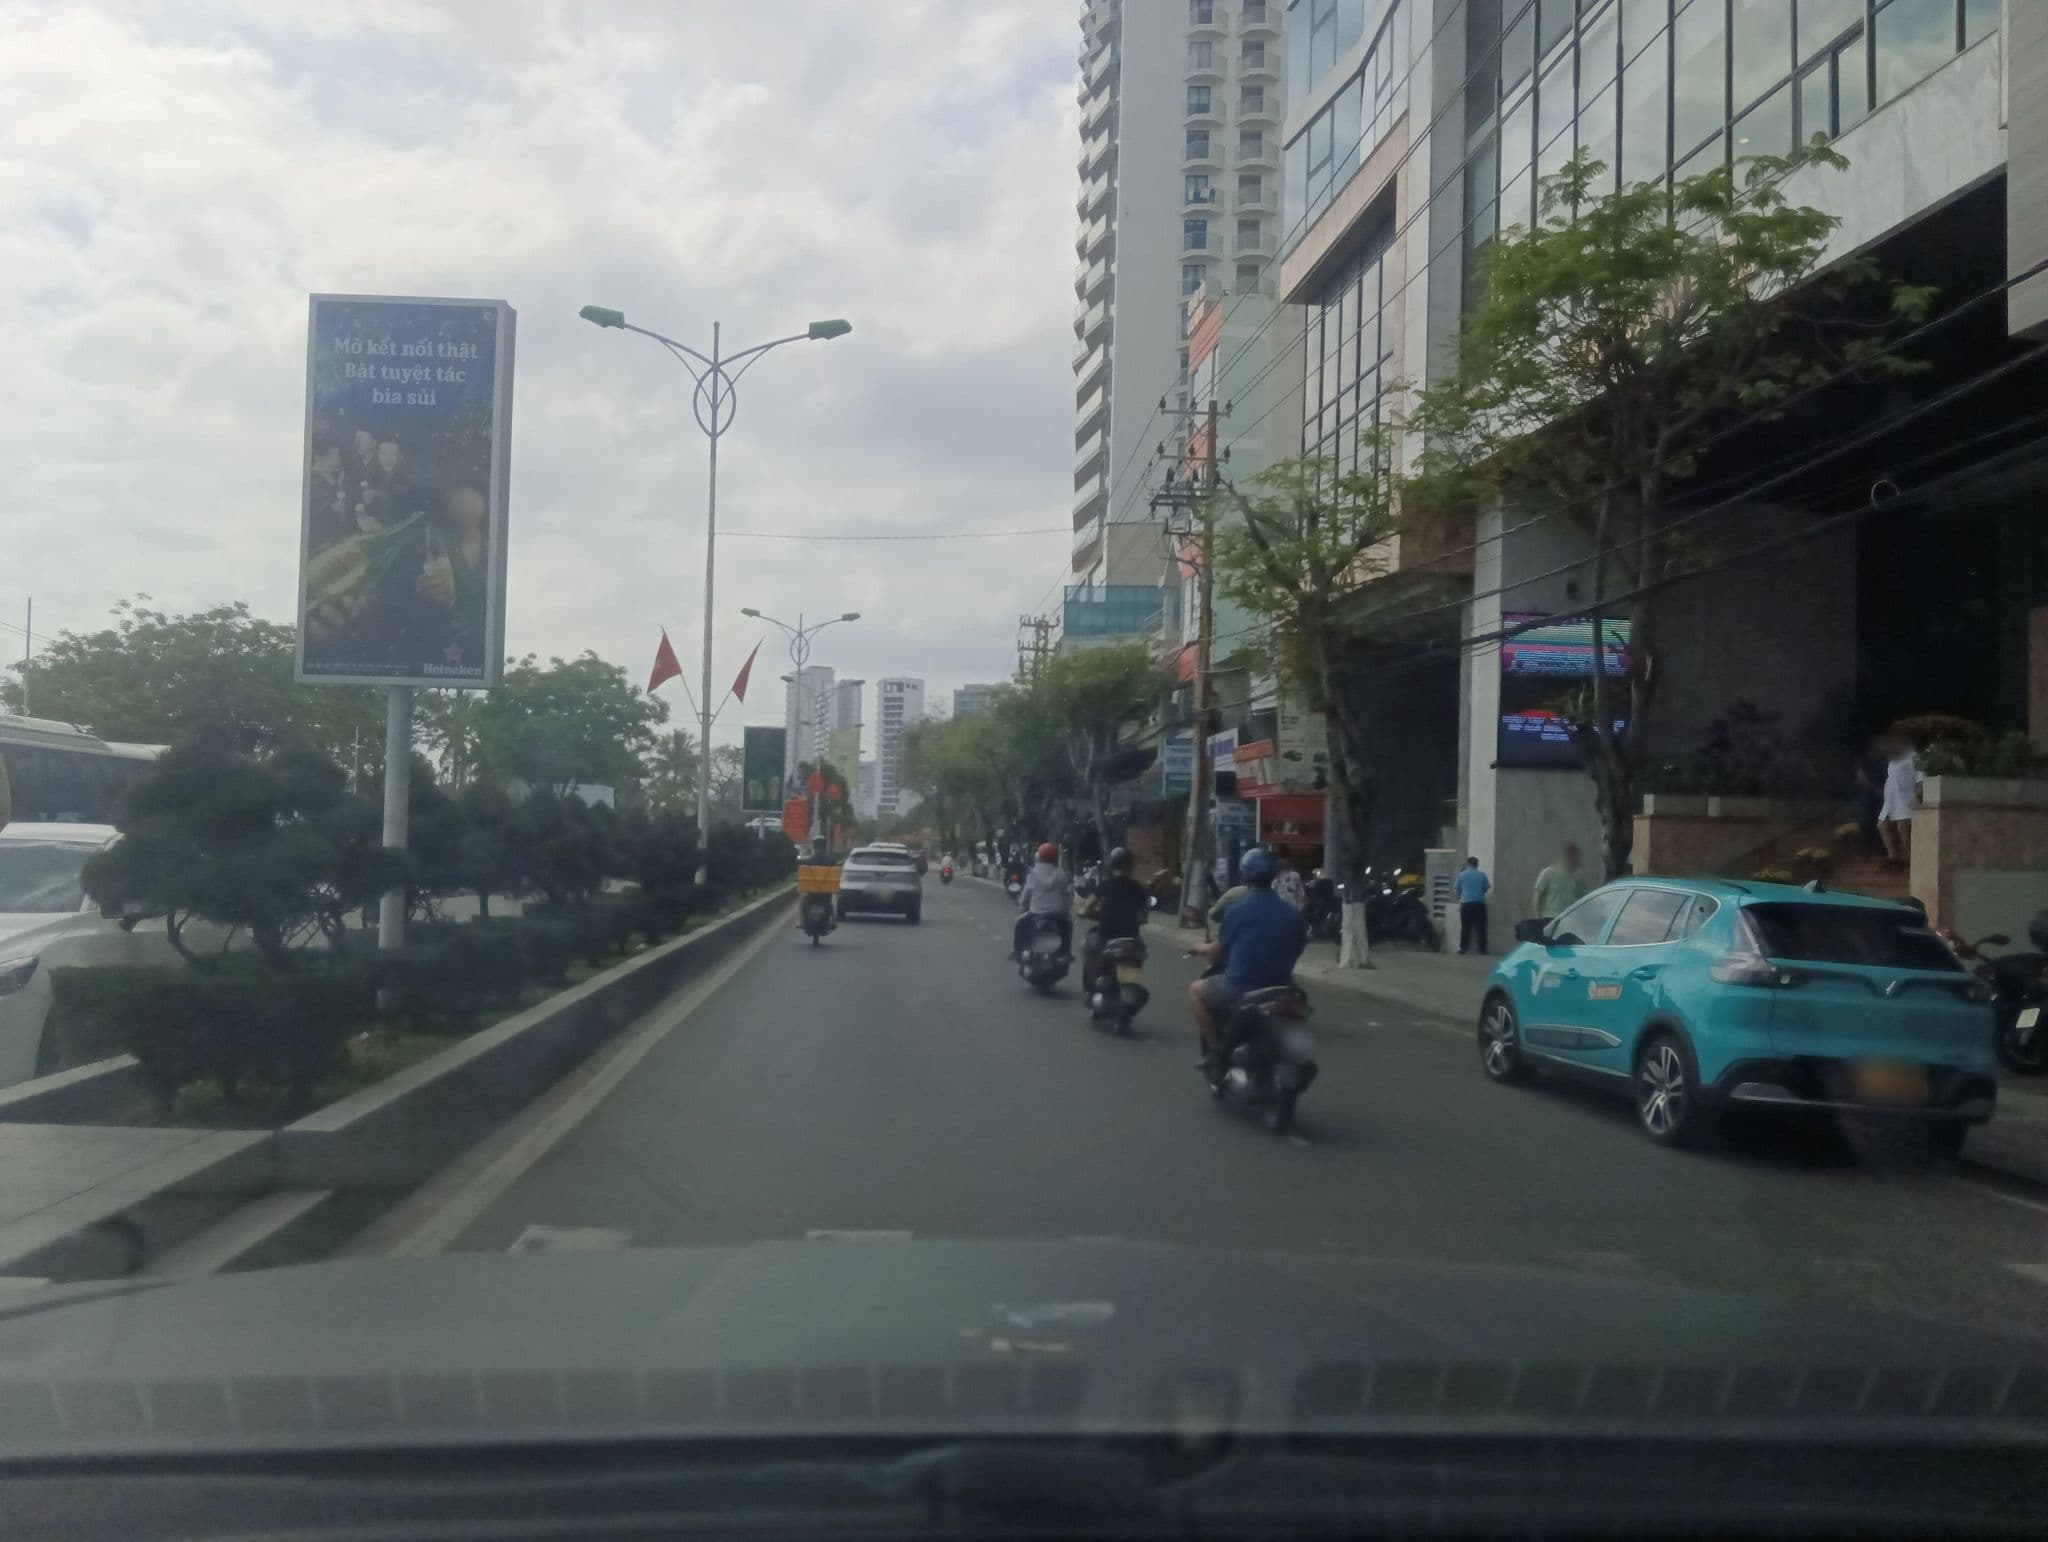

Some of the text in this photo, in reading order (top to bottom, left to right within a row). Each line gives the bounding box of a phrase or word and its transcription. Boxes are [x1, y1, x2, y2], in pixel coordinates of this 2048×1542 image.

[335, 336, 478, 363] Mở kết nối thật
[381, 364, 432, 384] tuyệt
[436, 365, 467, 382] tác
[372, 387, 436, 405] bia sủi
[424, 663, 482, 675] Heineken
